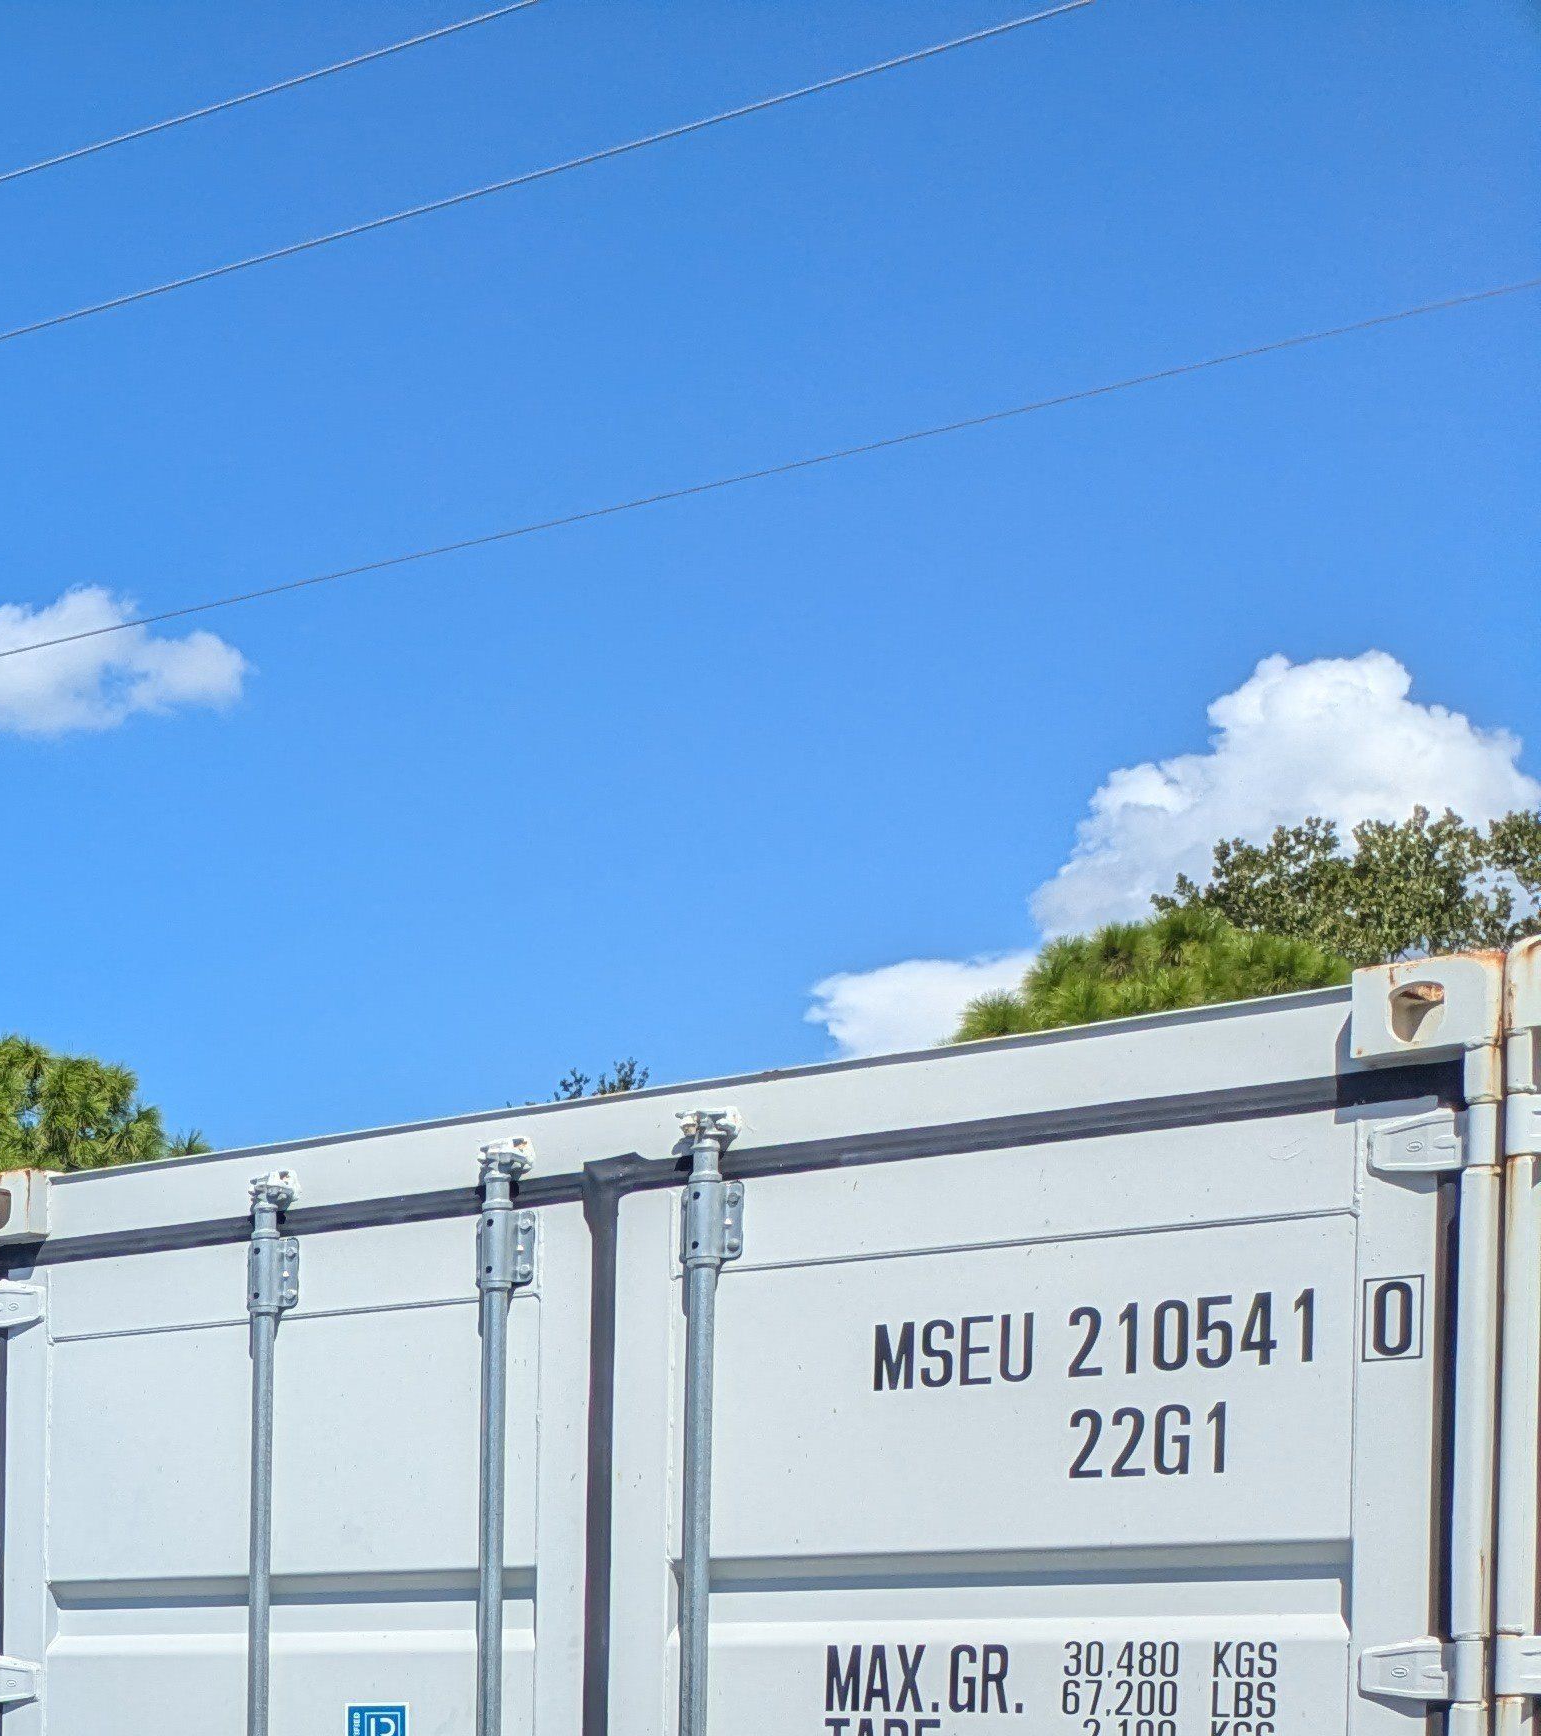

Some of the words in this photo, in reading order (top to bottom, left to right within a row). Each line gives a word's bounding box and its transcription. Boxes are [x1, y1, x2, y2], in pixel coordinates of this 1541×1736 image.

[872, 1312, 1034, 1391] MSEU
[1068, 1288, 1314, 1378] 210541
[1372, 1281, 1413, 1357] 0
[1069, 1401, 1226, 1479] 22G1
[1063, 1641, 1179, 1679] 30,480
[1213, 1641, 1278, 1679] KGS
[1061, 1680, 1178, 1717] 67,200
[1211, 1681, 1276, 1718] LBS
